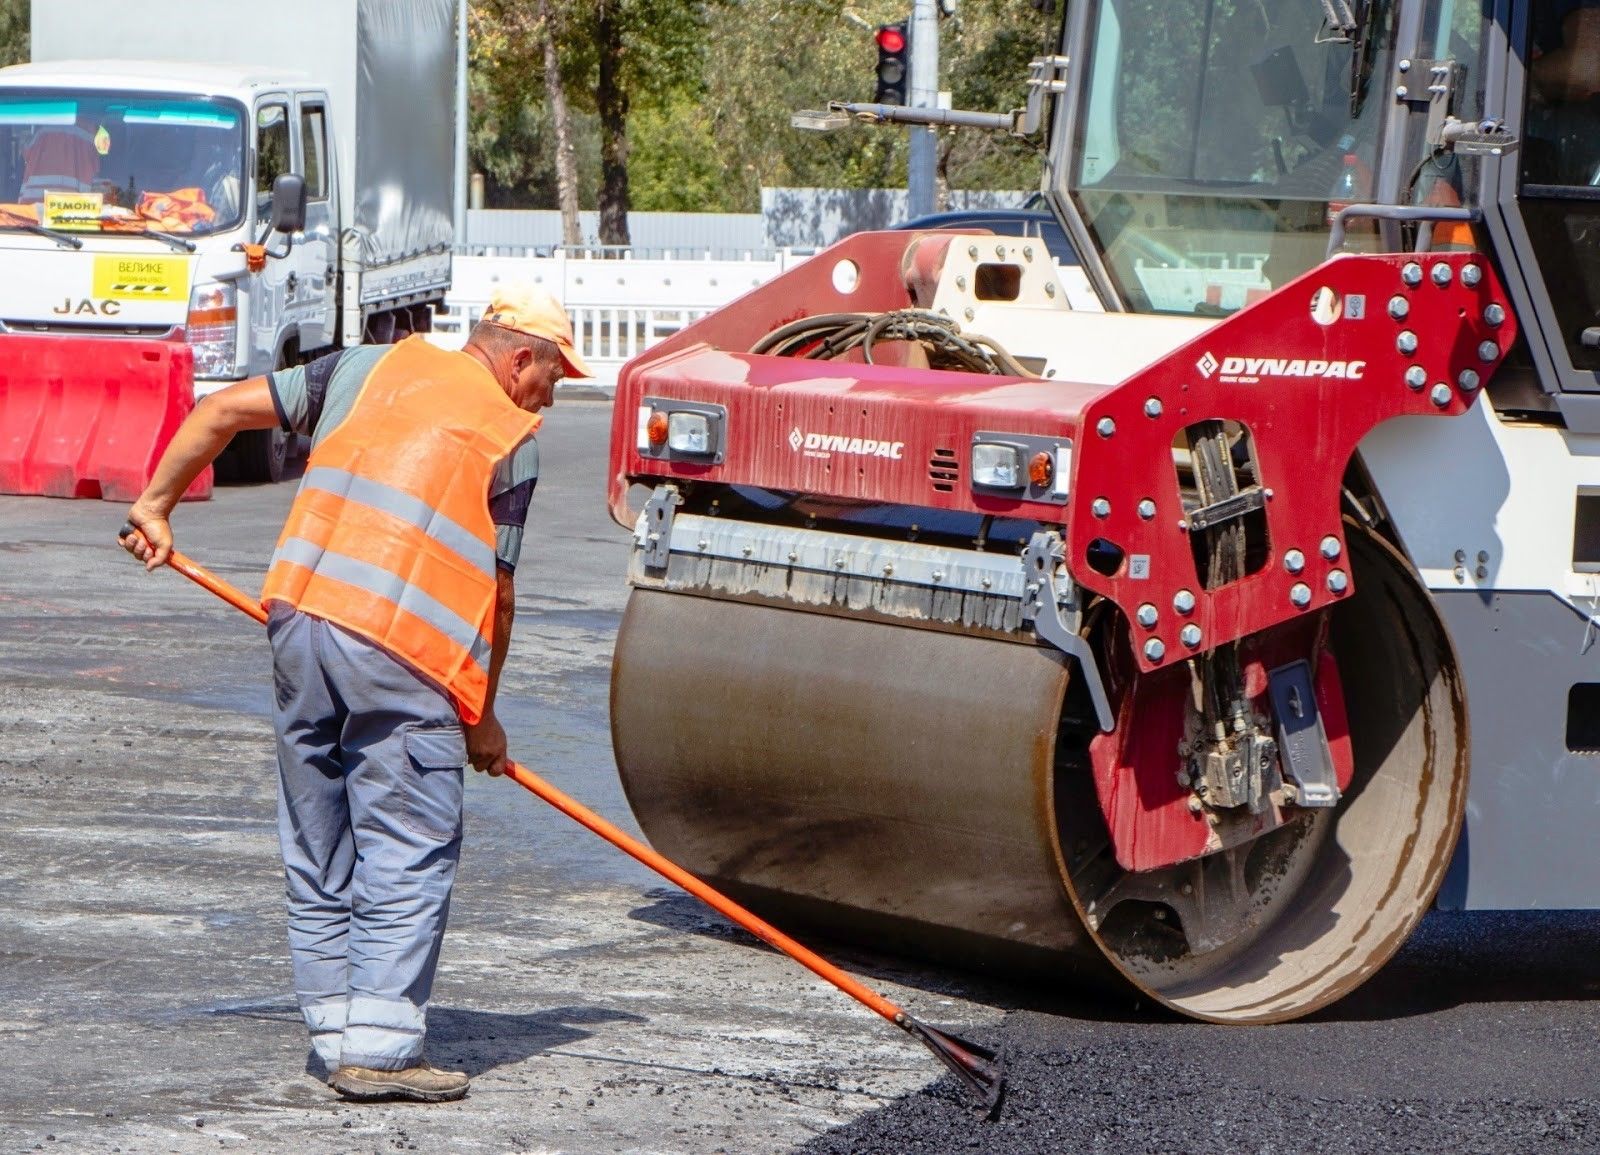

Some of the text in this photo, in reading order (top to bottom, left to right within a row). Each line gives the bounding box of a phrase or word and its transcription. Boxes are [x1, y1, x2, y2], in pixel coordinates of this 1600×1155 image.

[50, 201, 96, 210] РЕМОНТ
[118, 262, 163, 273] ВЕЛИКЕ
[53, 298, 120, 315] JAC
[1220, 357, 1367, 379] DYNAPAC
[804, 433, 904, 459] DYNAPAC
